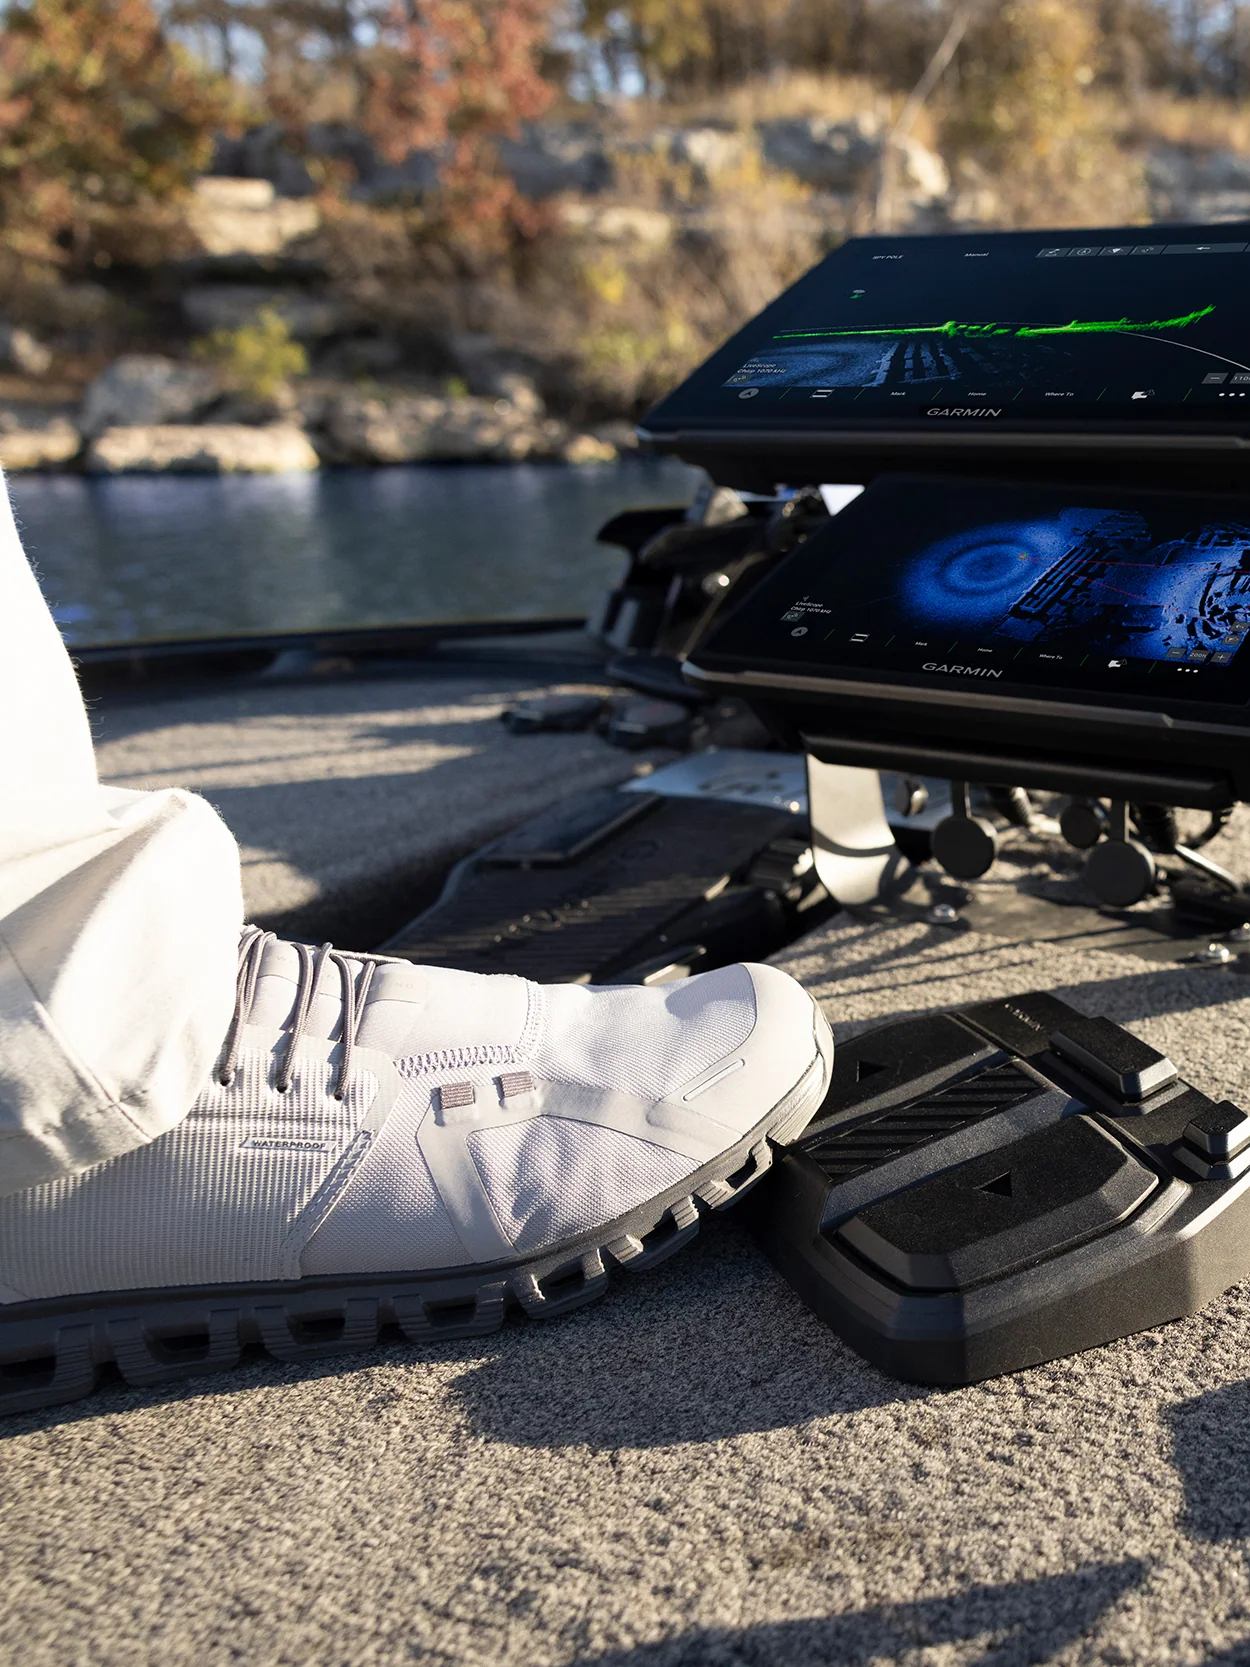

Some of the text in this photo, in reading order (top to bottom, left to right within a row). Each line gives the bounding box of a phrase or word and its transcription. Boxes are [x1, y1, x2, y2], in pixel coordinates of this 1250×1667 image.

[927, 407, 1002, 418] GARMIN
[922, 662, 1003, 678] GARMIN
[252, 1140, 326, 1149] WATERPROOF
